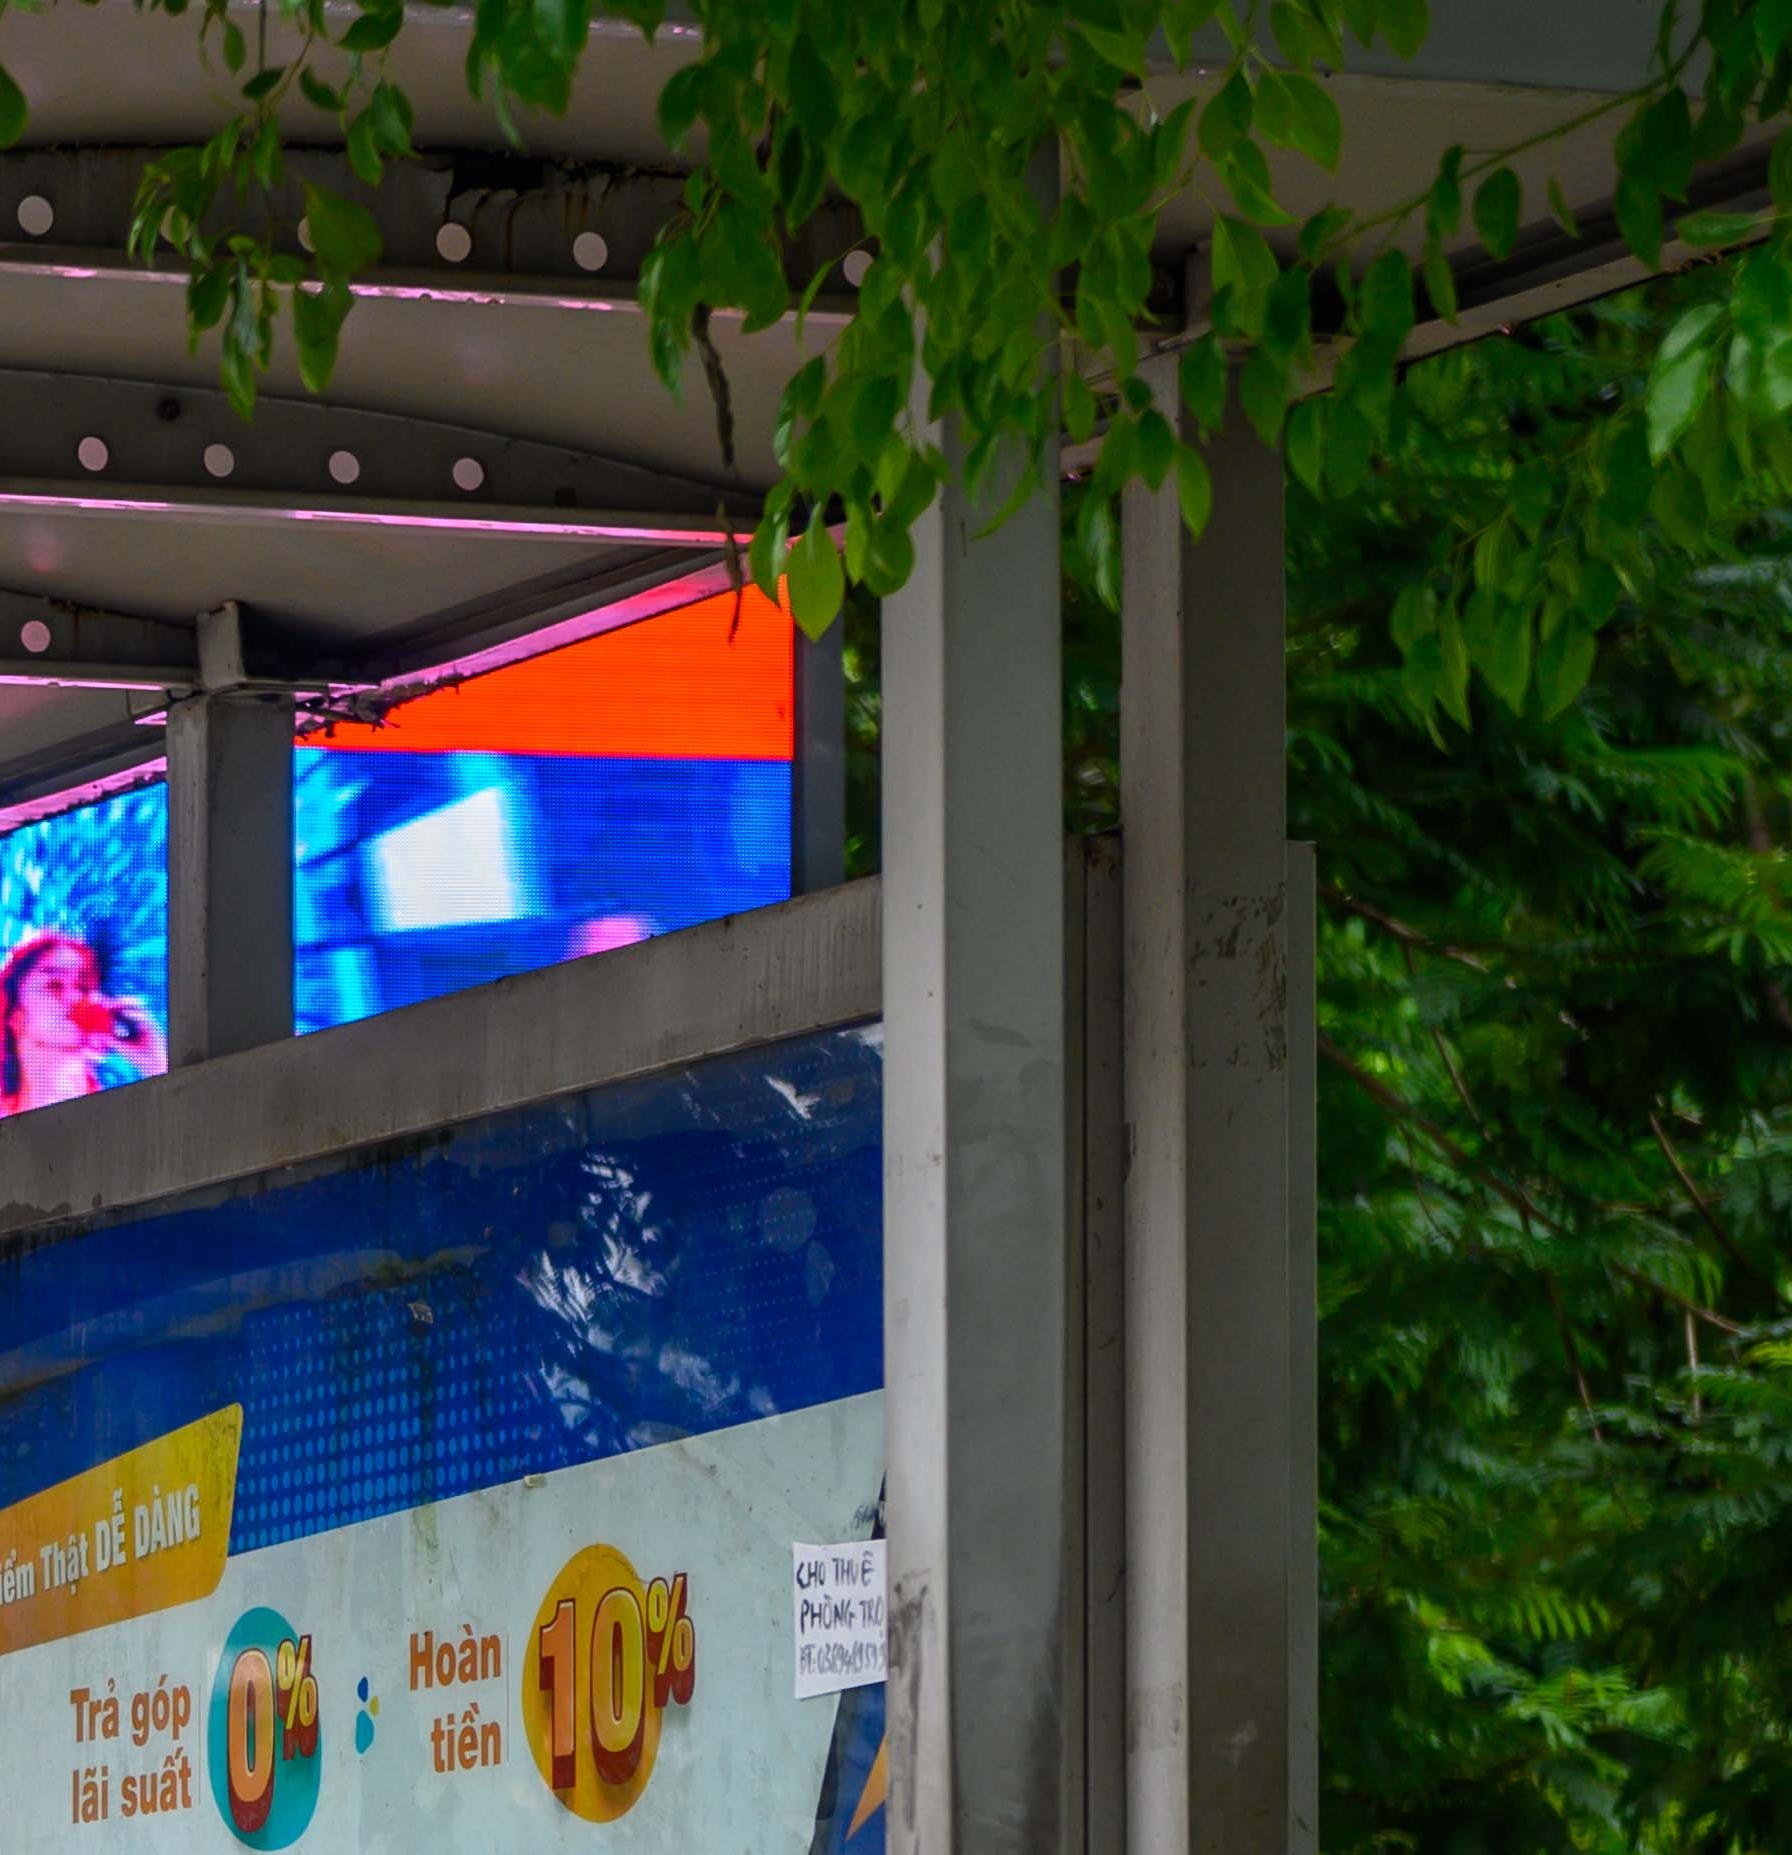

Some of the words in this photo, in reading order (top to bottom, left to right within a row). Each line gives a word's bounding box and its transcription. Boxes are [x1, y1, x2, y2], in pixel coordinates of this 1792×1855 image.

[40, 1531, 89, 1595] Thật
[95, 1486, 126, 1572] DỄ
[134, 1482, 201, 1559] DÀNG
[796, 1559, 825, 1589] CHO
[409, 1624, 501, 1691] Hoàn
[539, 1572, 695, 1790] 10%
[70, 1677, 119, 1743] Trả
[131, 1674, 191, 1748] góp
[228, 1633, 319, 1832] 0%
[431, 1702, 501, 1774] tiền
[72, 1765, 109, 1824] lãi
[121, 1746, 192, 1818] suất
